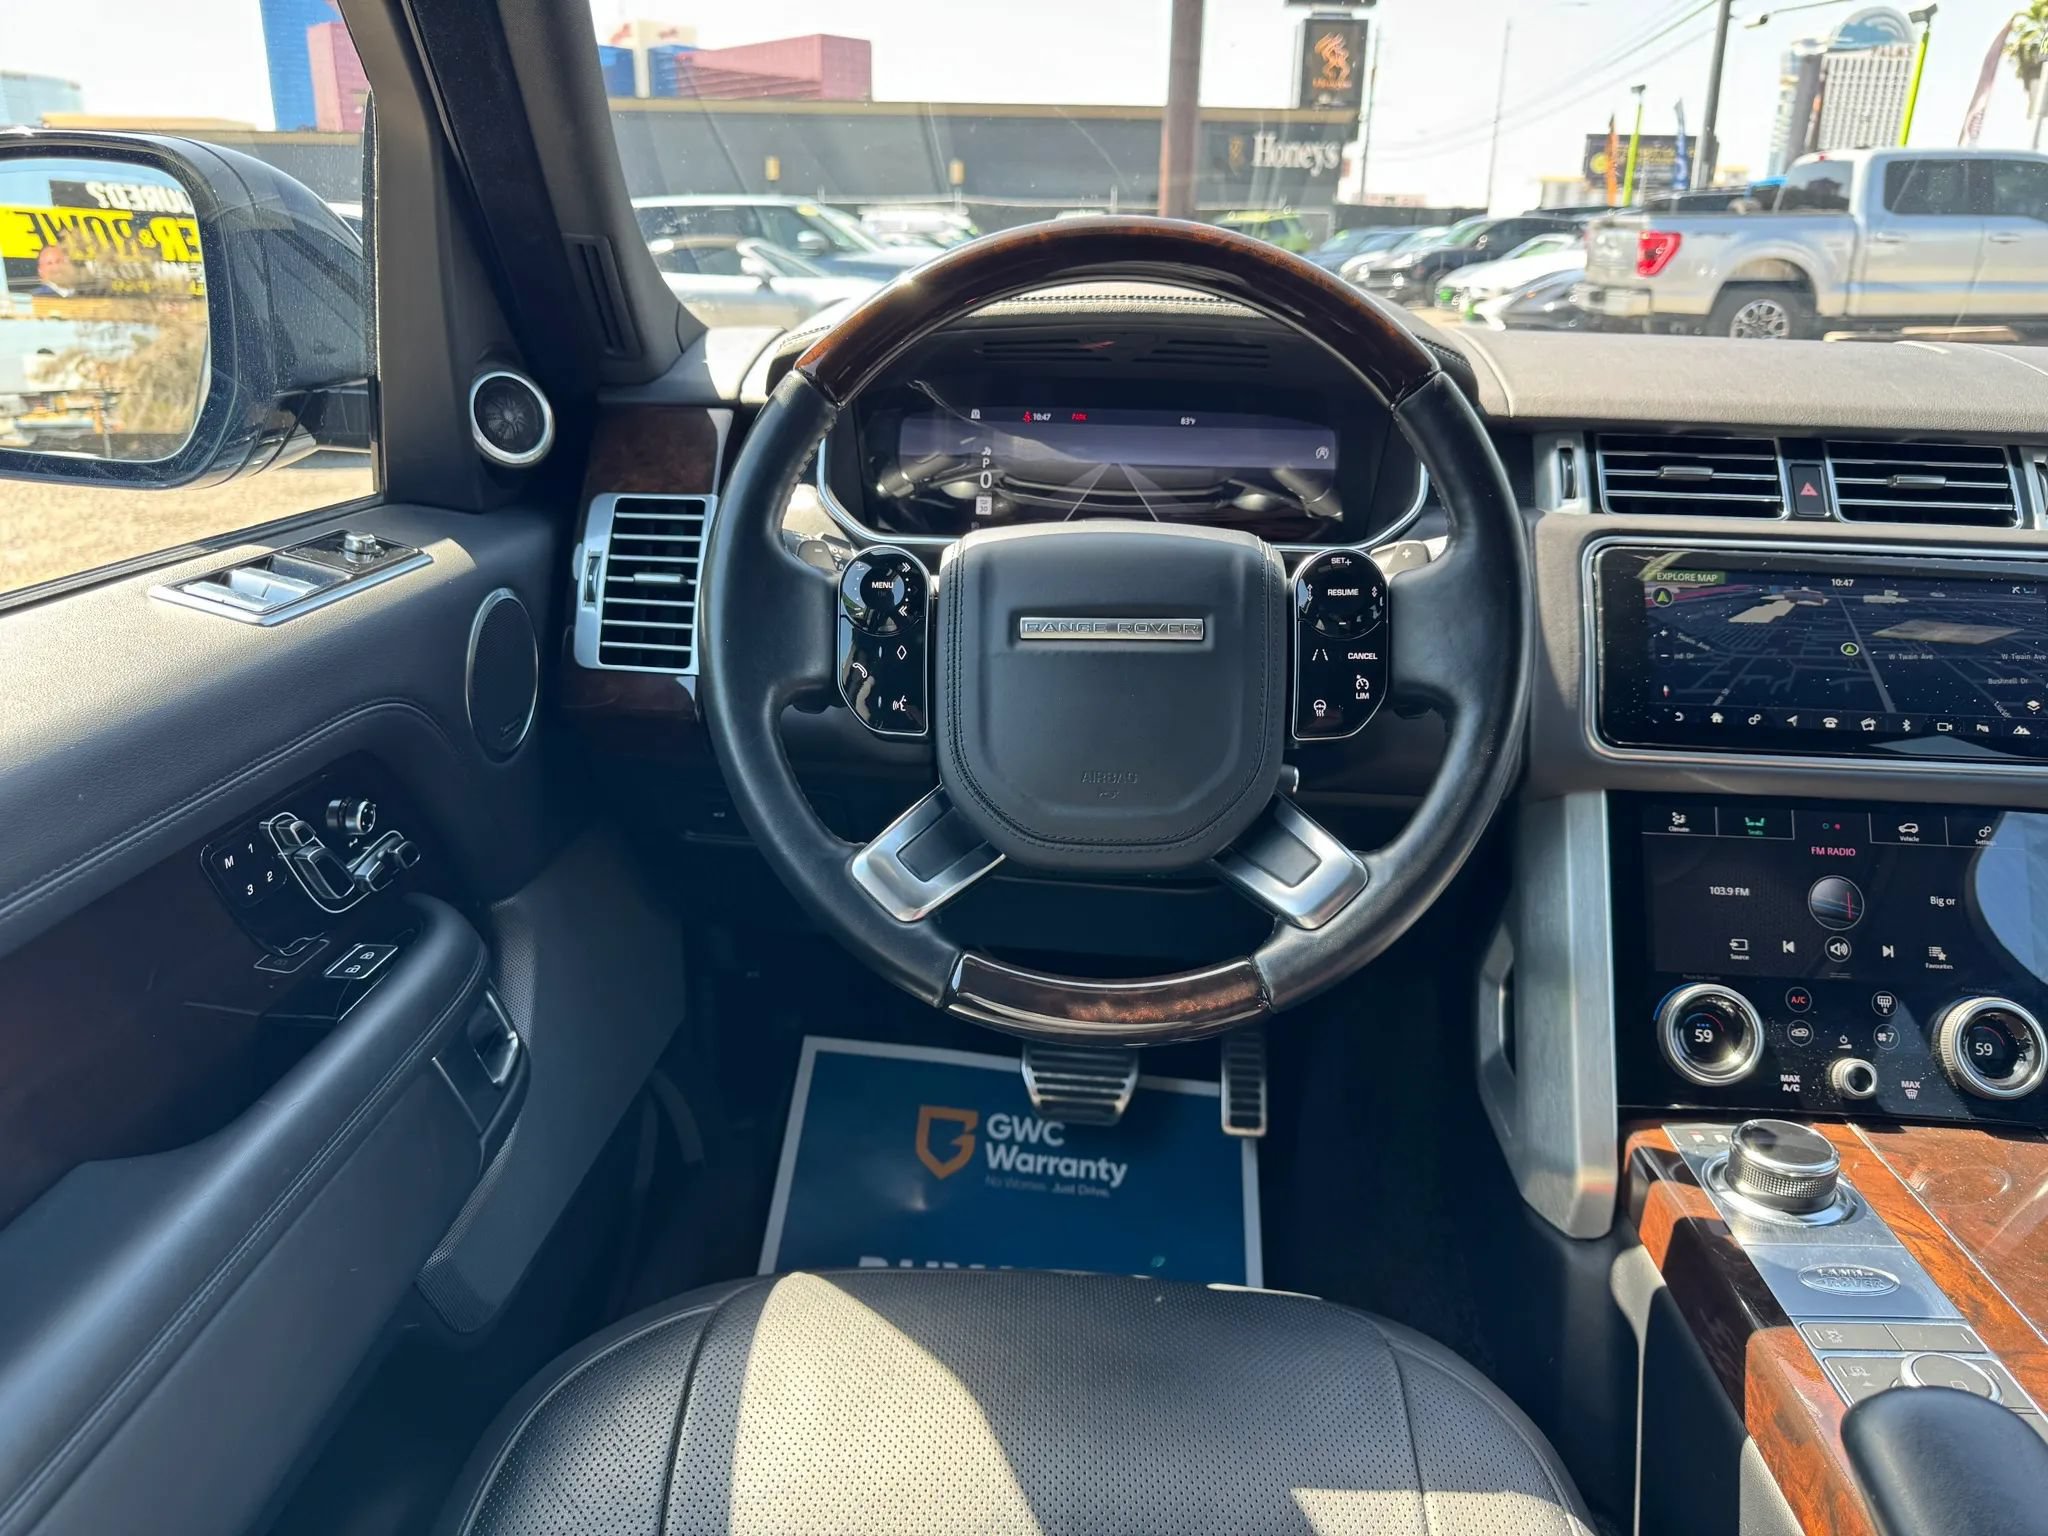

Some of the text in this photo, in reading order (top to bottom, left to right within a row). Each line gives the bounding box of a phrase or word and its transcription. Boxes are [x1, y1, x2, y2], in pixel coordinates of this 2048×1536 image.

[1033, 412, 1051, 421] 10:47
[982, 458, 990, 468] P
[980, 472, 992, 489] 0
[1656, 573, 1718, 583] EXPLORE MAP
[1831, 578, 1854, 587] 10:47
[871, 581, 894, 589] MENU
[1327, 588, 1359, 596] RESUME
[1025, 622, 1199, 635] RANGE ROVER
[1348, 652, 1378, 660] CANCEL
[1356, 692, 1370, 700] LIM
[1668, 825, 1690, 833] Climate
[248, 843, 254, 854] 1
[1811, 846, 1856, 857] FM RADIO
[224, 855, 235, 869] M
[267, 871, 274, 882] 2
[247, 884, 254, 895] 3
[1709, 886, 1750, 897] 103.9 FM
[1930, 896, 1956, 907] Big or
[1730, 953, 1750, 961] Source
[1791, 996, 1806, 1004] A/C
[1694, 1028, 1714, 1043] 59
[1887, 1032, 1895, 1043] 7
[1975, 1042, 1993, 1056] 59
[1780, 1074, 1801, 1082] MAX
[1782, 1084, 1801, 1092] A/C
[1901, 1080, 1921, 1089] MAX
[986, 1112, 1066, 1147] GWC
[985, 1141, 1128, 1189] Warranty
